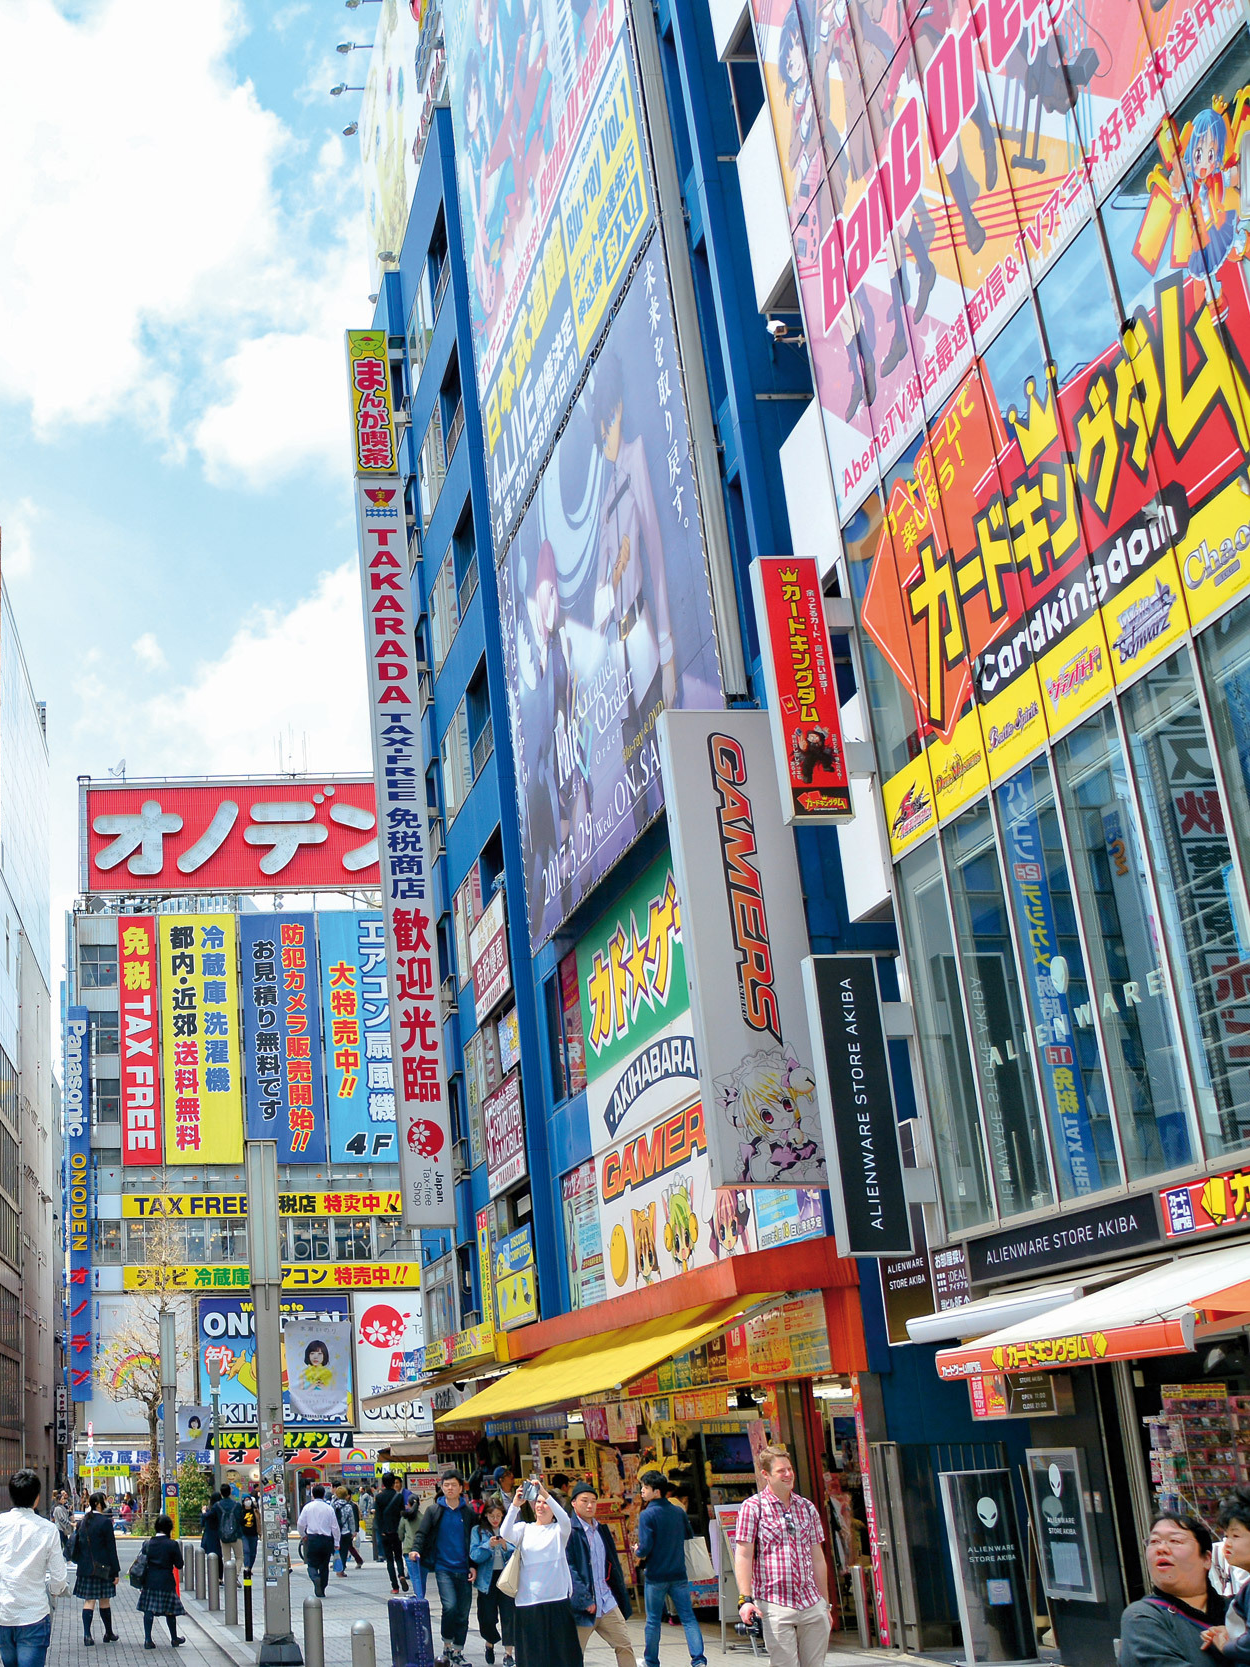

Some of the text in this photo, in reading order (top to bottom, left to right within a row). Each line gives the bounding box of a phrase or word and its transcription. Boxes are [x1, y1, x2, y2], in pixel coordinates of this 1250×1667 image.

[485, 216, 567, 456] 日本武道館
[353, 358, 392, 469] まんが喫茶
[884, 386, 976, 537] カードゲームで
[911, 280, 1250, 722] カードキングダム
[367, 528, 412, 704] TAKARADA
[783, 584, 819, 722] カードキングダム
[576, 655, 614, 718] Grand
[595, 668, 633, 735] Order
[92, 785, 380, 875] オノデン
[386, 807, 426, 900] 免税商店
[541, 811, 593, 906] 2017.3.29
[614, 765, 637, 817] ON
[707, 732, 784, 1048] GAMERS
[122, 926, 156, 1151] 免税 TAX FREE
[251, 940, 282, 1122] お見積り無料です
[67, 1019, 87, 1138] Panasonic
[611, 1038, 695, 1124] AKIHABARA
[839, 977, 884, 1231] ALIENWARE STORE AKIBA
[346, 1133, 392, 1156] 4F
[494, 1100, 521, 1142] COMPUTER
[501, 1126, 523, 1162] MOBILE
[71, 1153, 87, 1252] ONODEN
[134, 1196, 249, 1215] TAX FREE
[413, 1181, 422, 1206] Shop
[422, 1167, 432, 1206] Tax-free
[1168, 1191, 1188, 1207] カード
[1170, 1205, 1192, 1219] ゲーム
[887, 1257, 924, 1274] ALIENWARE
[986, 1214, 1138, 1264] ALIENWARE STORE AKIBA
[281, 1269, 328, 1284] アコン
[889, 1273, 926, 1290] STORE AKIBA
[70, 1266, 90, 1386] オノデン
[1006, 1335, 1090, 1368] カードキングダム
[1022, 1402, 1035, 1410] CLOSE
[968, 1544, 1015, 1554] ALIENWARE
[1047, 1517, 1075, 1525] ALIENWARE
[1048, 1526, 1077, 1535] STORE AKIBA
[969, 1553, 1017, 1563] STORE AKIBA
